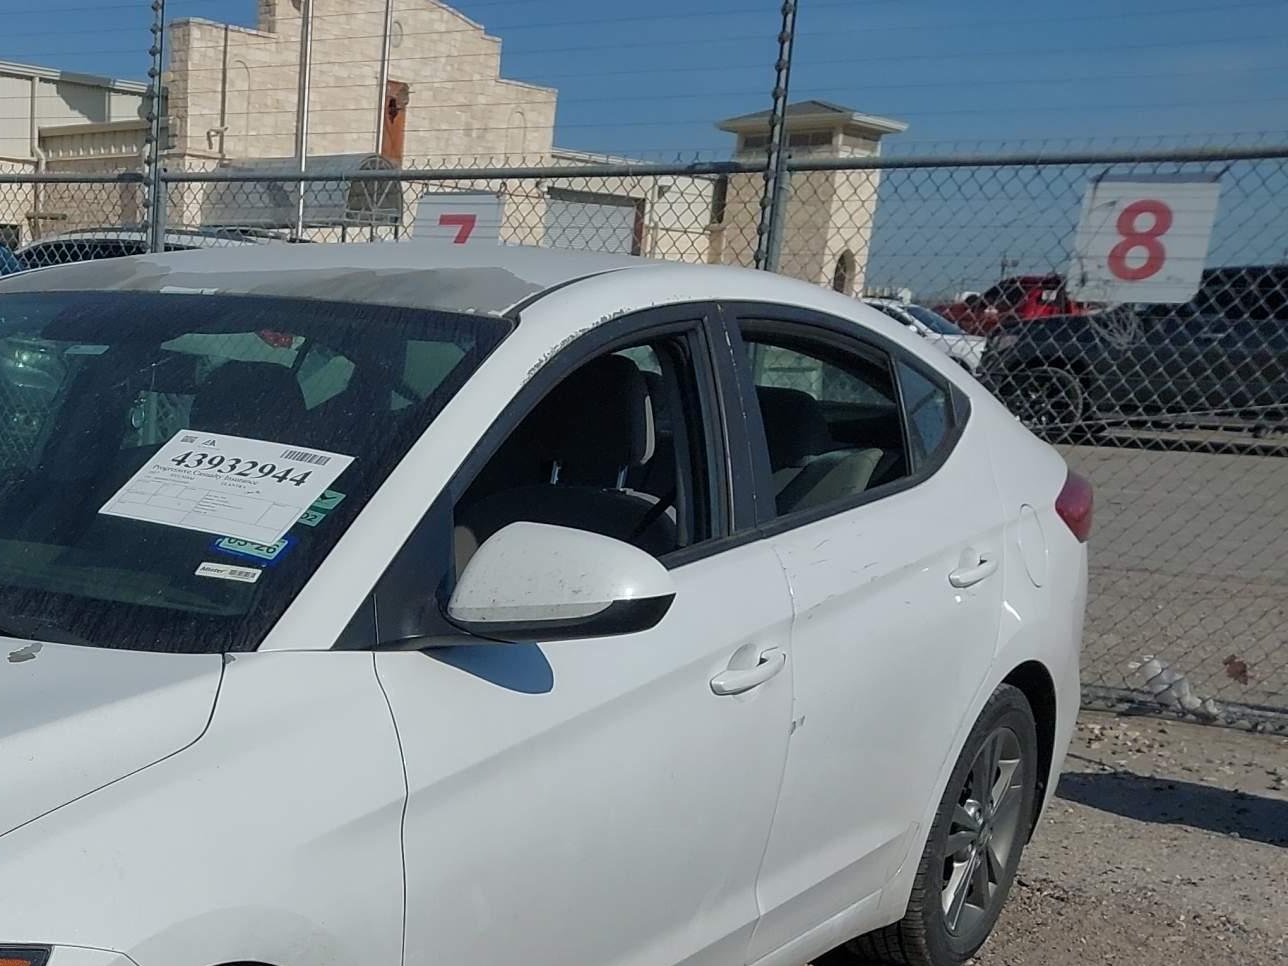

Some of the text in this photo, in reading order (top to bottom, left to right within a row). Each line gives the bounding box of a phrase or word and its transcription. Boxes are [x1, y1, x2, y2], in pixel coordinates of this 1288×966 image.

[438, 213, 478, 245] 7
[1107, 199, 1174, 282] 8
[171, 450, 313, 487] 43932944
